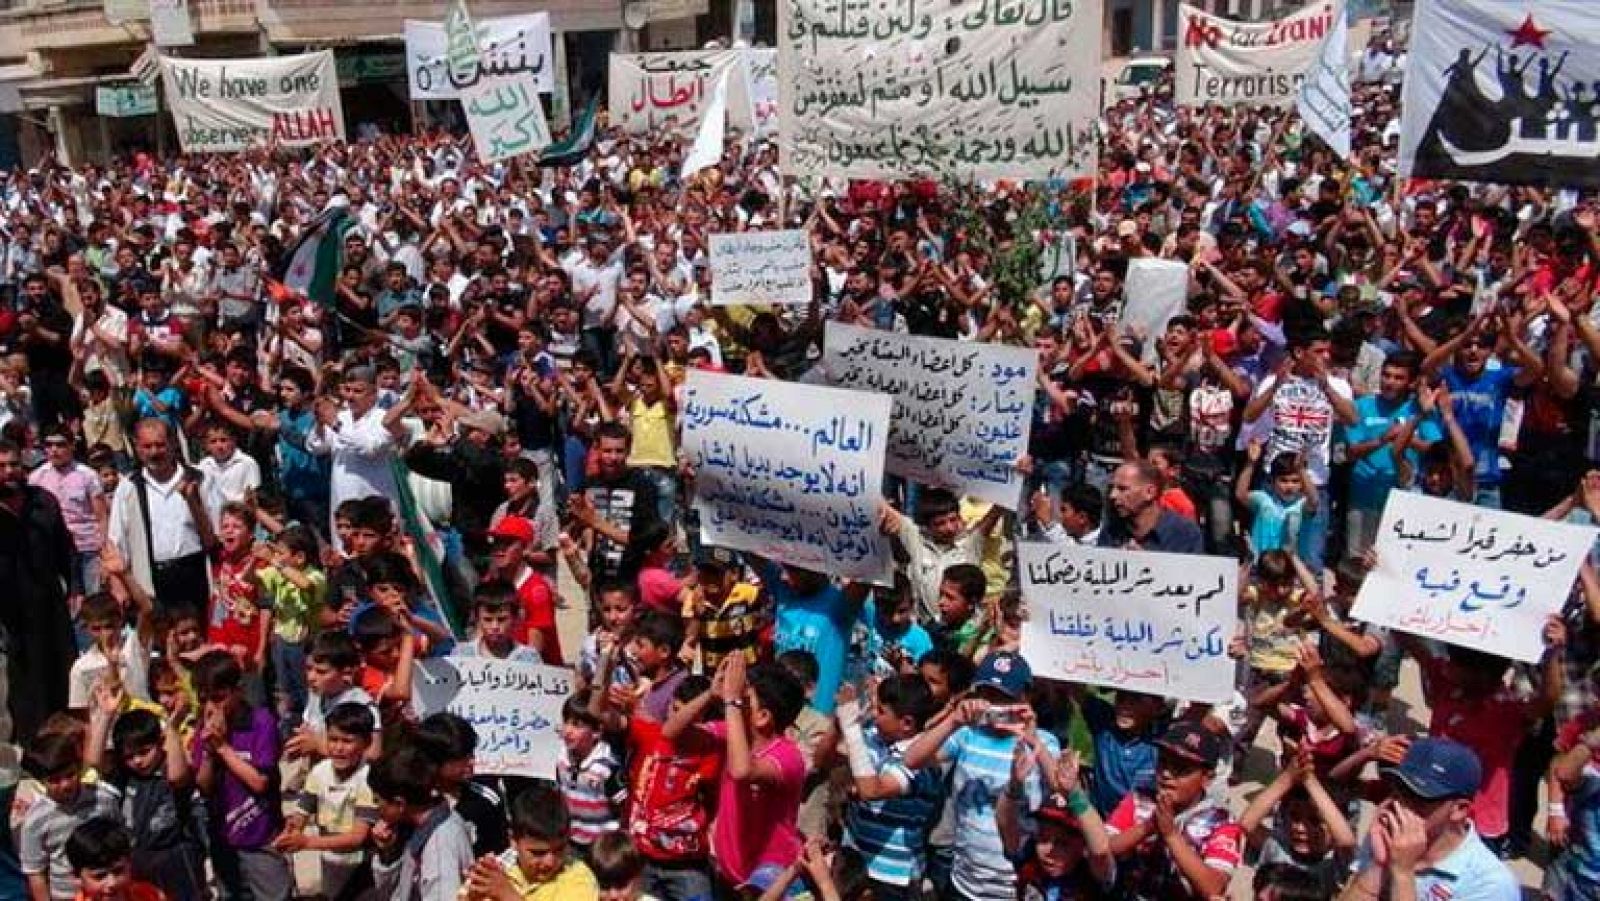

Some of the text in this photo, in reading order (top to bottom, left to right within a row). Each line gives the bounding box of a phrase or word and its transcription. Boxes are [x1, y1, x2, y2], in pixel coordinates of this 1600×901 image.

[1185, 14, 1222, 48] No
[171, 64, 321, 98] We have one
[948, 57, 996, 104] الله
[468, 80, 531, 117] الله
[271, 107, 338, 143] ALLAH
[812, 415, 872, 458] العالم
[1532, 548, 1567, 569] من
[1119, 565, 1154, 594] شر
[1151, 584, 1194, 609] يعد
[1195, 573, 1224, 617] لم
[1415, 566, 1526, 613] وقع فيه
[1151, 626, 1184, 654] شر
